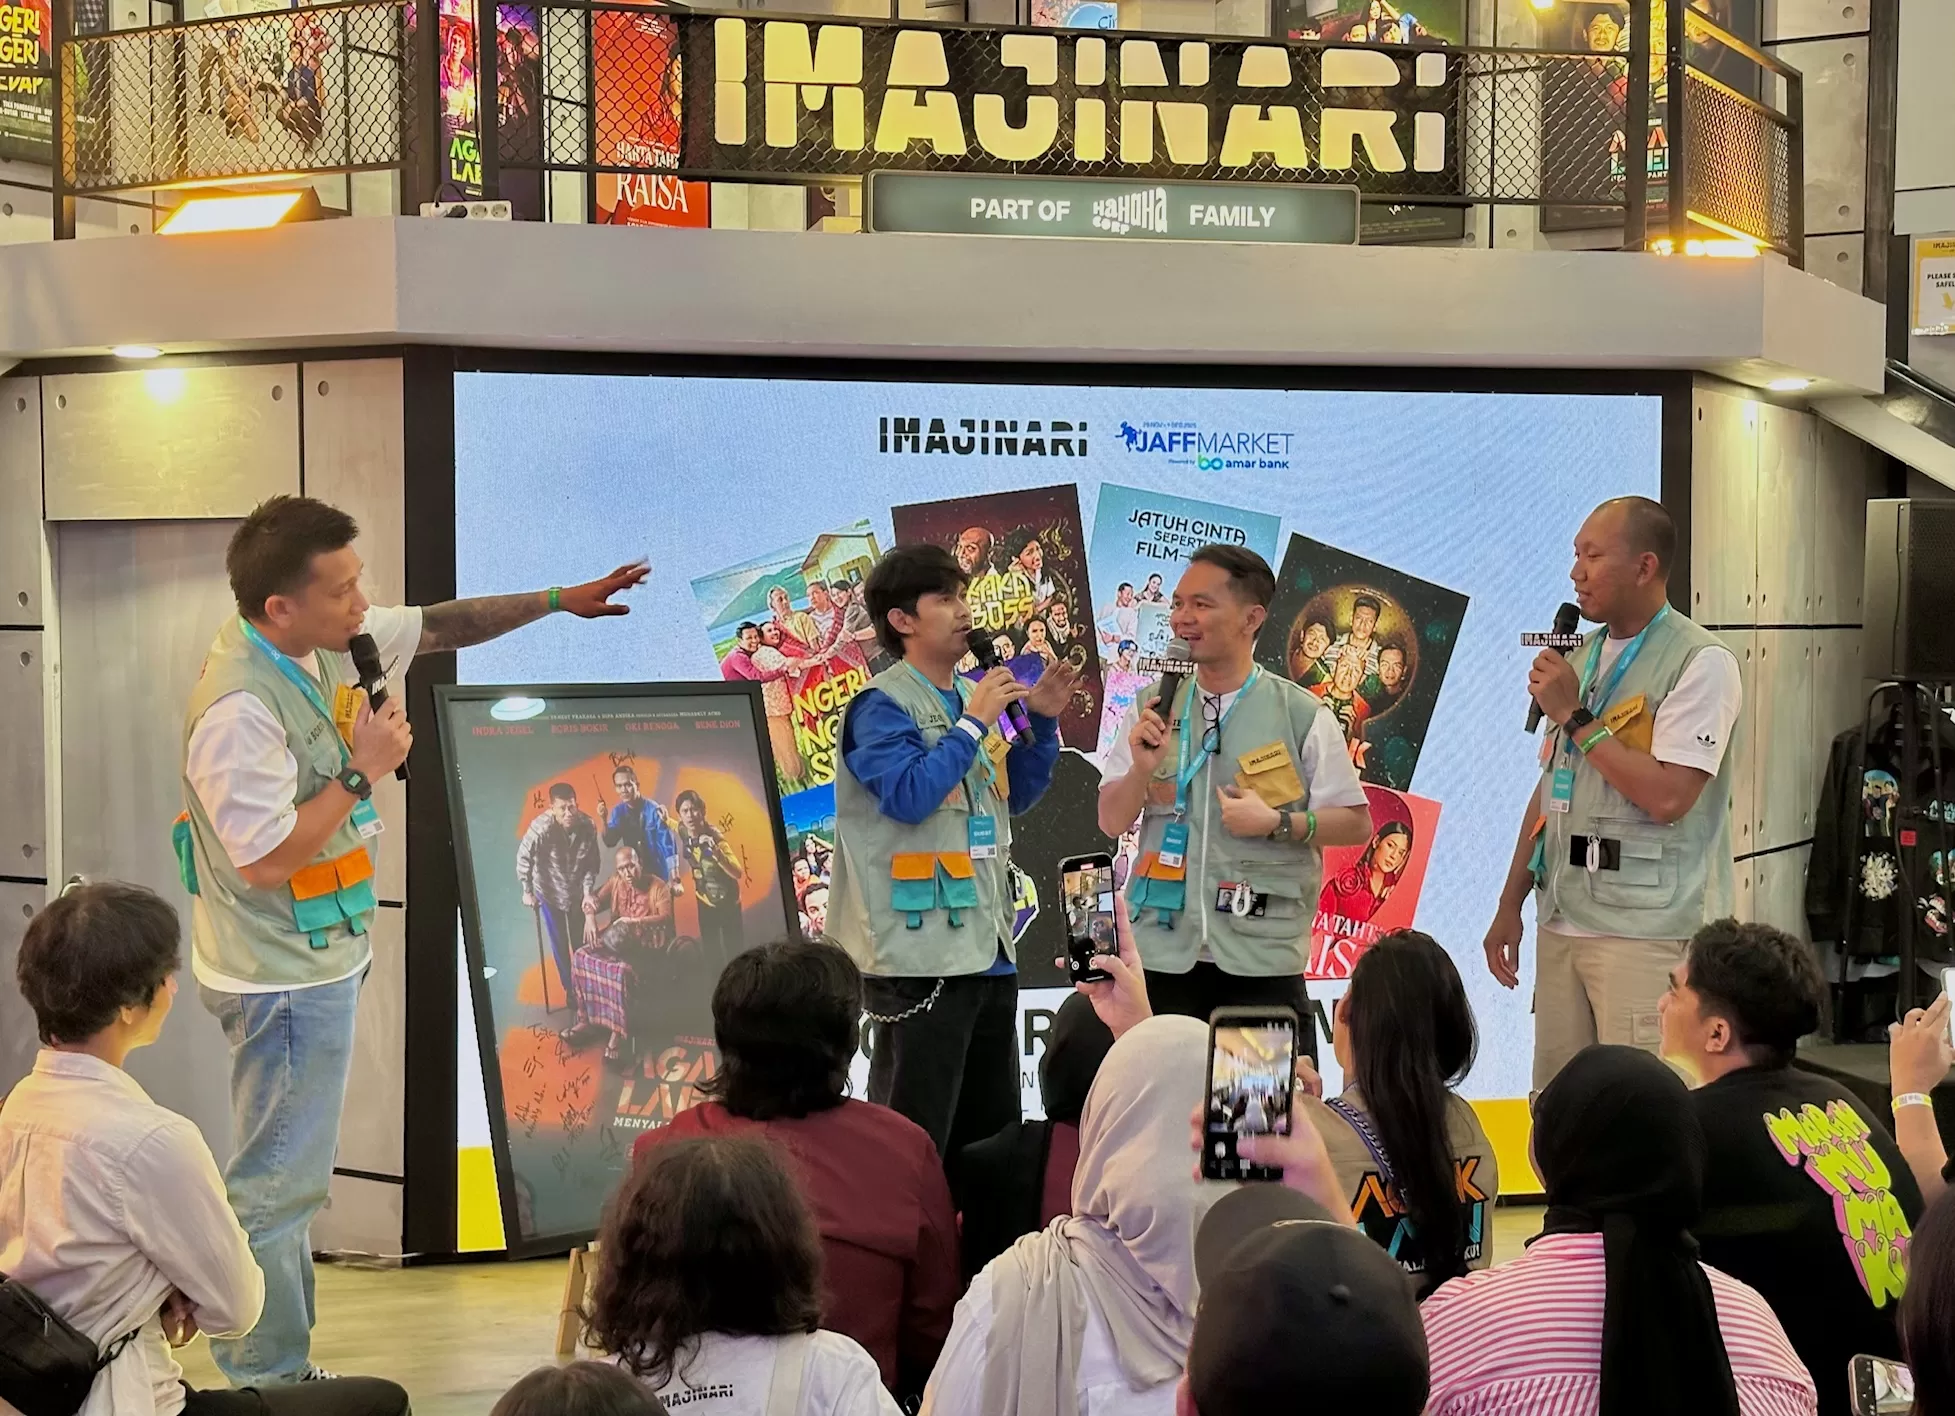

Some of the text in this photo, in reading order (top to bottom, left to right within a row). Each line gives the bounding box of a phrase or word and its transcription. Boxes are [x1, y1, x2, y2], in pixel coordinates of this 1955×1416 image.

[714, 17, 1447, 173] IMAJINARI
[450, 137, 480, 163] AG
[970, 198, 1034, 219] PART
[1038, 200, 1071, 221] OF
[1189, 204, 1276, 228] FAMILY
[1092, 216, 1130, 235] CORP
[1926, 272, 1951, 280] PLEASE
[879, 416, 1088, 457] IMAJINARI
[1225, 458, 1257, 469] amar
[1259, 457, 1290, 469] bank
[1128, 509, 1247, 547] JATUH CINTA
[971, 597, 1036, 630] BOSS
[1521, 633, 1583, 647] IMAJINARI
[625, 722, 642, 732] OKI
[719, 719, 740, 729] DION
[622, 1046, 716, 1081] AGA
[1804, 1139, 1892, 1196] MU
[659, 1384, 733, 1408] MAJINARI
